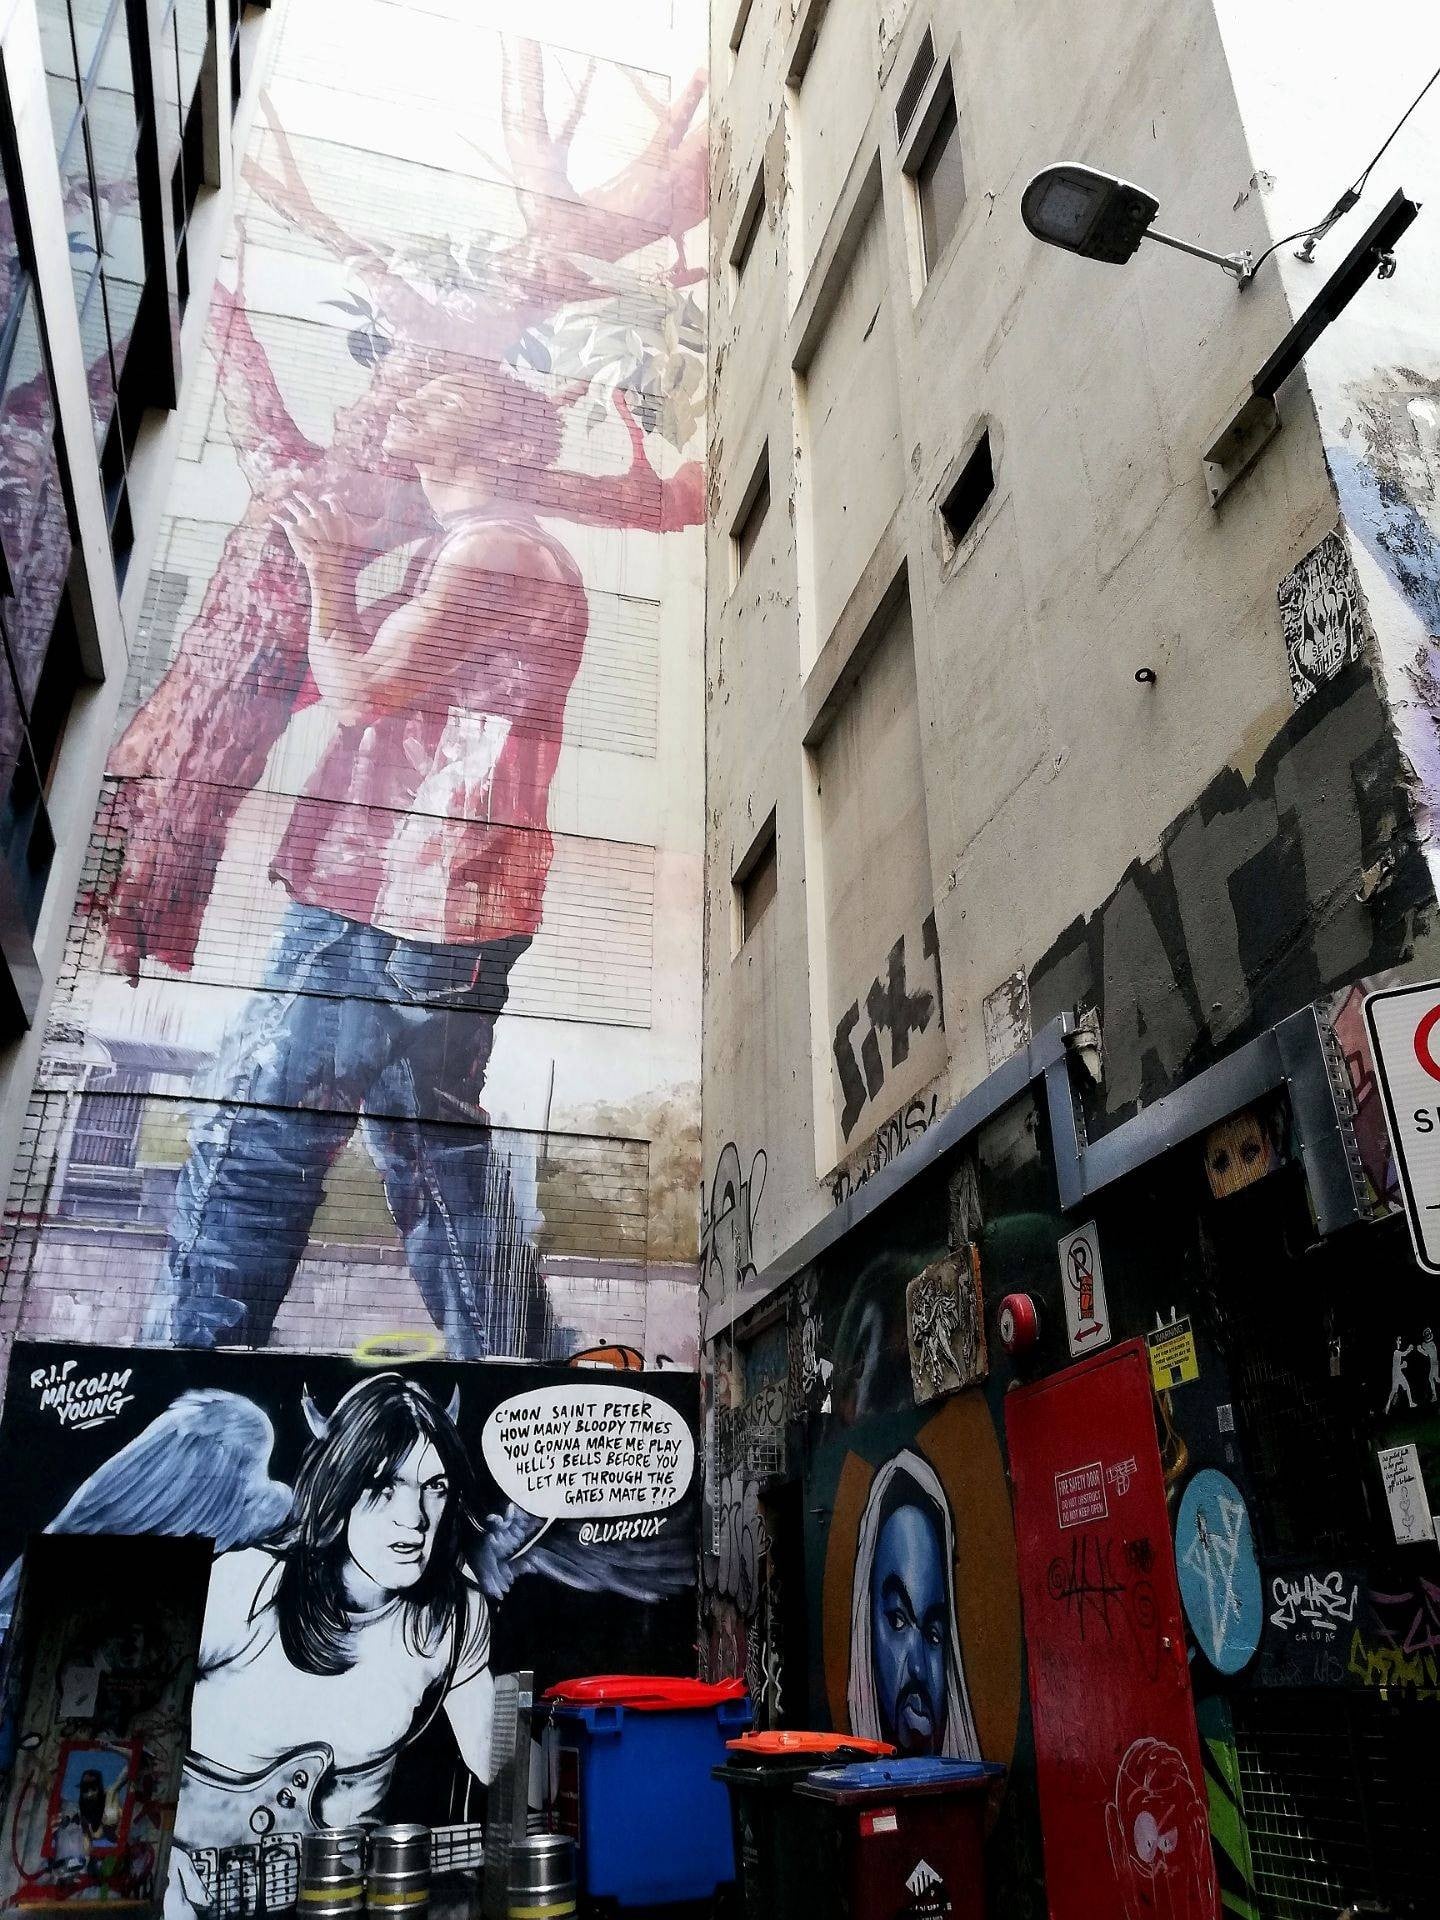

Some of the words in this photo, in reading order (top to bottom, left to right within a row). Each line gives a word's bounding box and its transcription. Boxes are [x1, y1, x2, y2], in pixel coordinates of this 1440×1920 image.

[1312, 626, 1339, 657] SELFIE
[1315, 642, 1341, 675] THIS
[40, 1368, 132, 1411] MALCOLM
[57, 1391, 135, 1425] YOUNG
[495, 1407, 541, 1423] C'MON
[552, 1403, 597, 1418] SAINT
[604, 1403, 652, 1418] PETER
[500, 1425, 530, 1442] HOW
[533, 1421, 571, 1436] MANY
[574, 1419, 626, 1434] BLOODY
[630, 1420, 673, 1435] TIMES
[503, 1443, 529, 1460] YOU
[534, 1438, 580, 1454] GONNA
[586, 1436, 623, 1451] MAKE
[626, 1438, 644, 1450] ME
[650, 1440, 682, 1454] PLAY
[516, 1456, 555, 1475] HELL'S
[562, 1452, 601, 1468] BELLS
[606, 1451, 651, 1467] BEFORE
[656, 1454, 679, 1469] YOU
[527, 1474, 552, 1492] LET
[556, 1472, 578, 1486] ME
[582, 1471, 643, 1486] THROUGH
[647, 1471, 674, 1485] THE
[1069, 1475, 1086, 1494] SAFETY
[565, 1487, 604, 1505] GATES
[609, 1487, 647, 1502] MATE
[578, 1516, 668, 1546] @LUSHSUX
